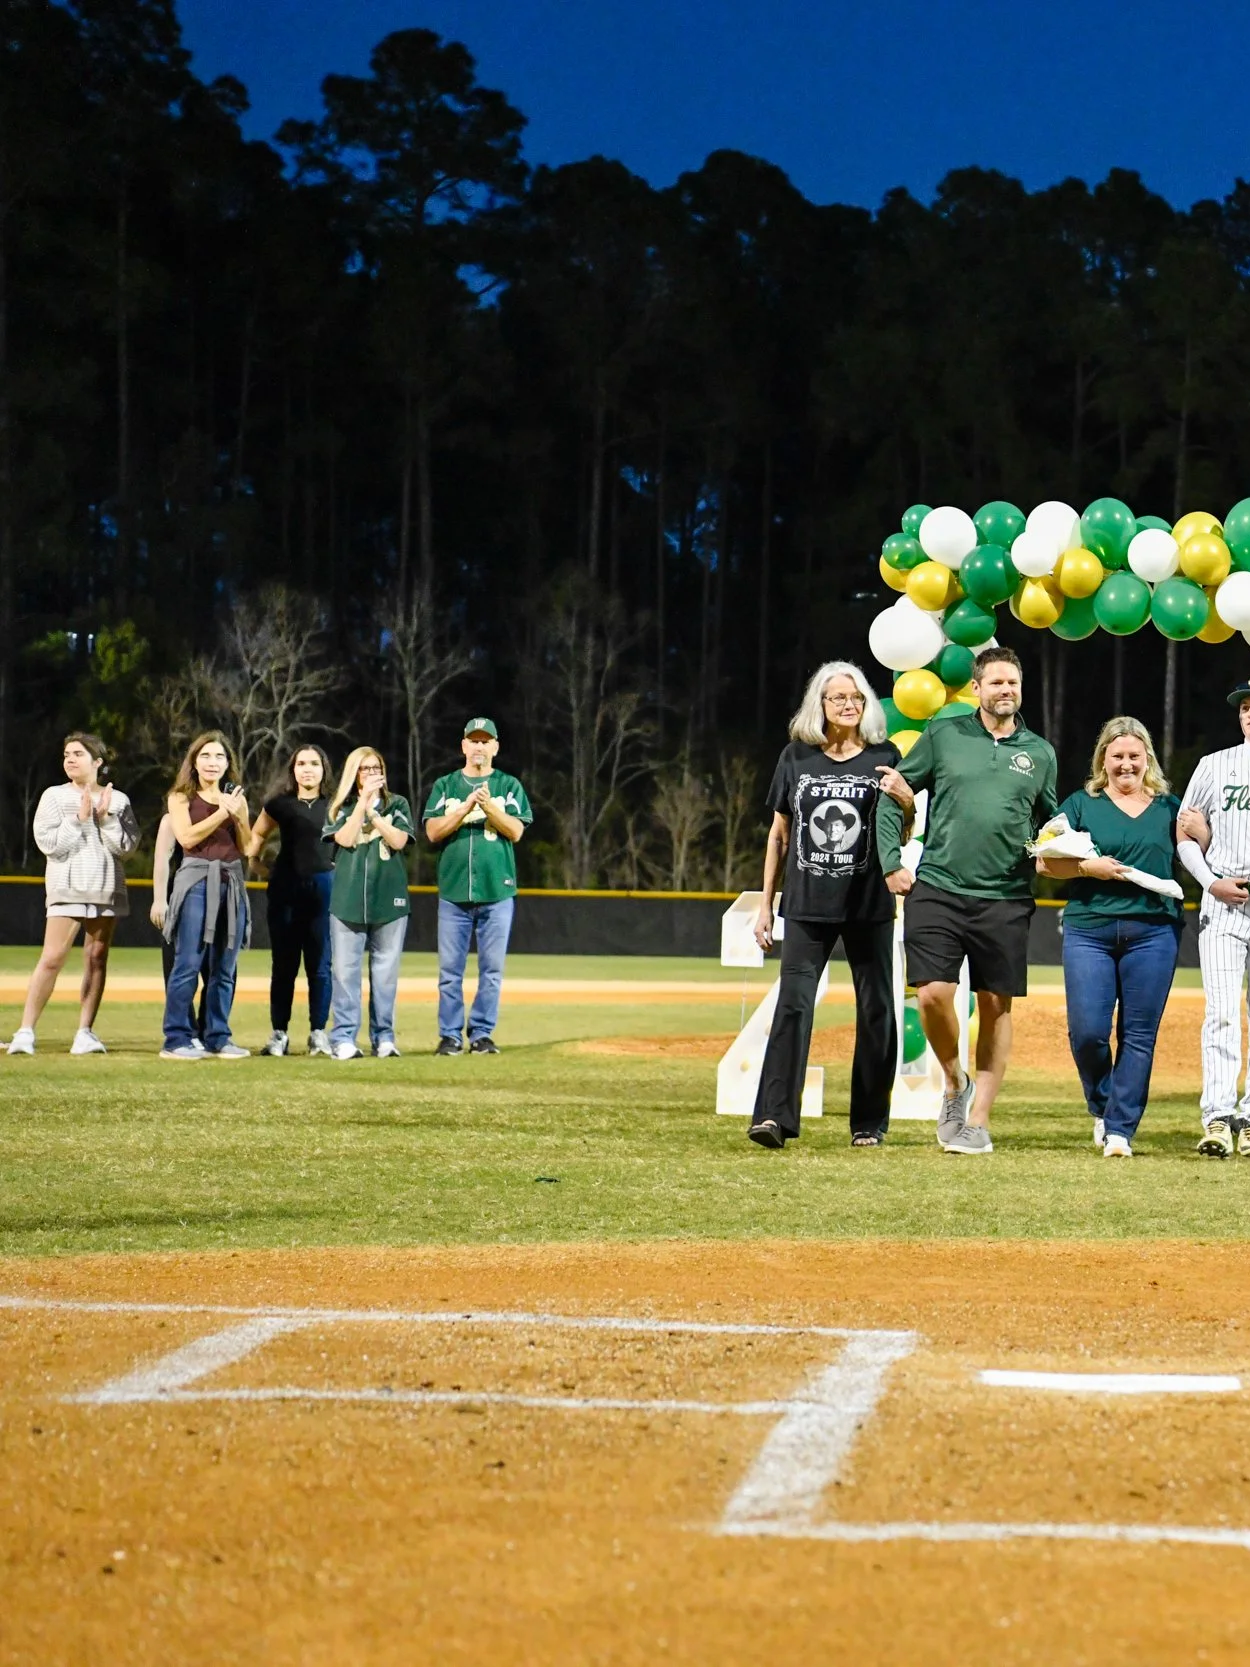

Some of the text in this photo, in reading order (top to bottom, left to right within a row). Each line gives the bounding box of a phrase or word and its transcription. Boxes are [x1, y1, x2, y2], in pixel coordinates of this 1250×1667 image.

[810, 786, 868, 799] STRAIT
[810, 851, 854, 864] 2024 TOUR
